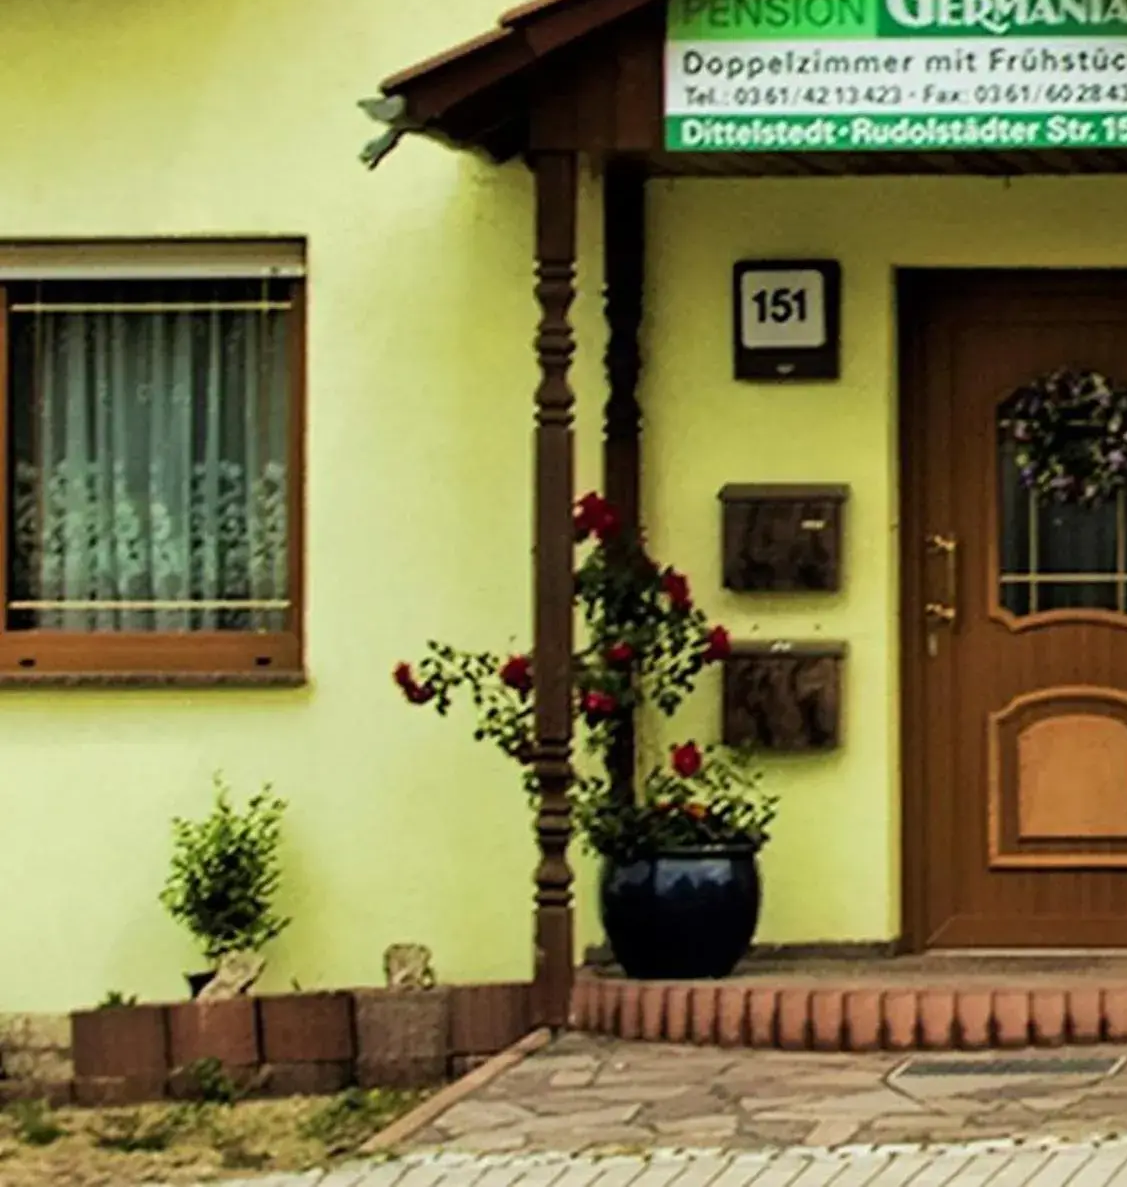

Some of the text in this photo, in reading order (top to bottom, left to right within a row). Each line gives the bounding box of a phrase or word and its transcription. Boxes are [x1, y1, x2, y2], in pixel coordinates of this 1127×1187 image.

[683, 49, 913, 79] Doppelzimmer
[925, 48, 977, 73] mit
[1046, 115, 1099, 144] Str.
[752, 288, 807, 323] 151
